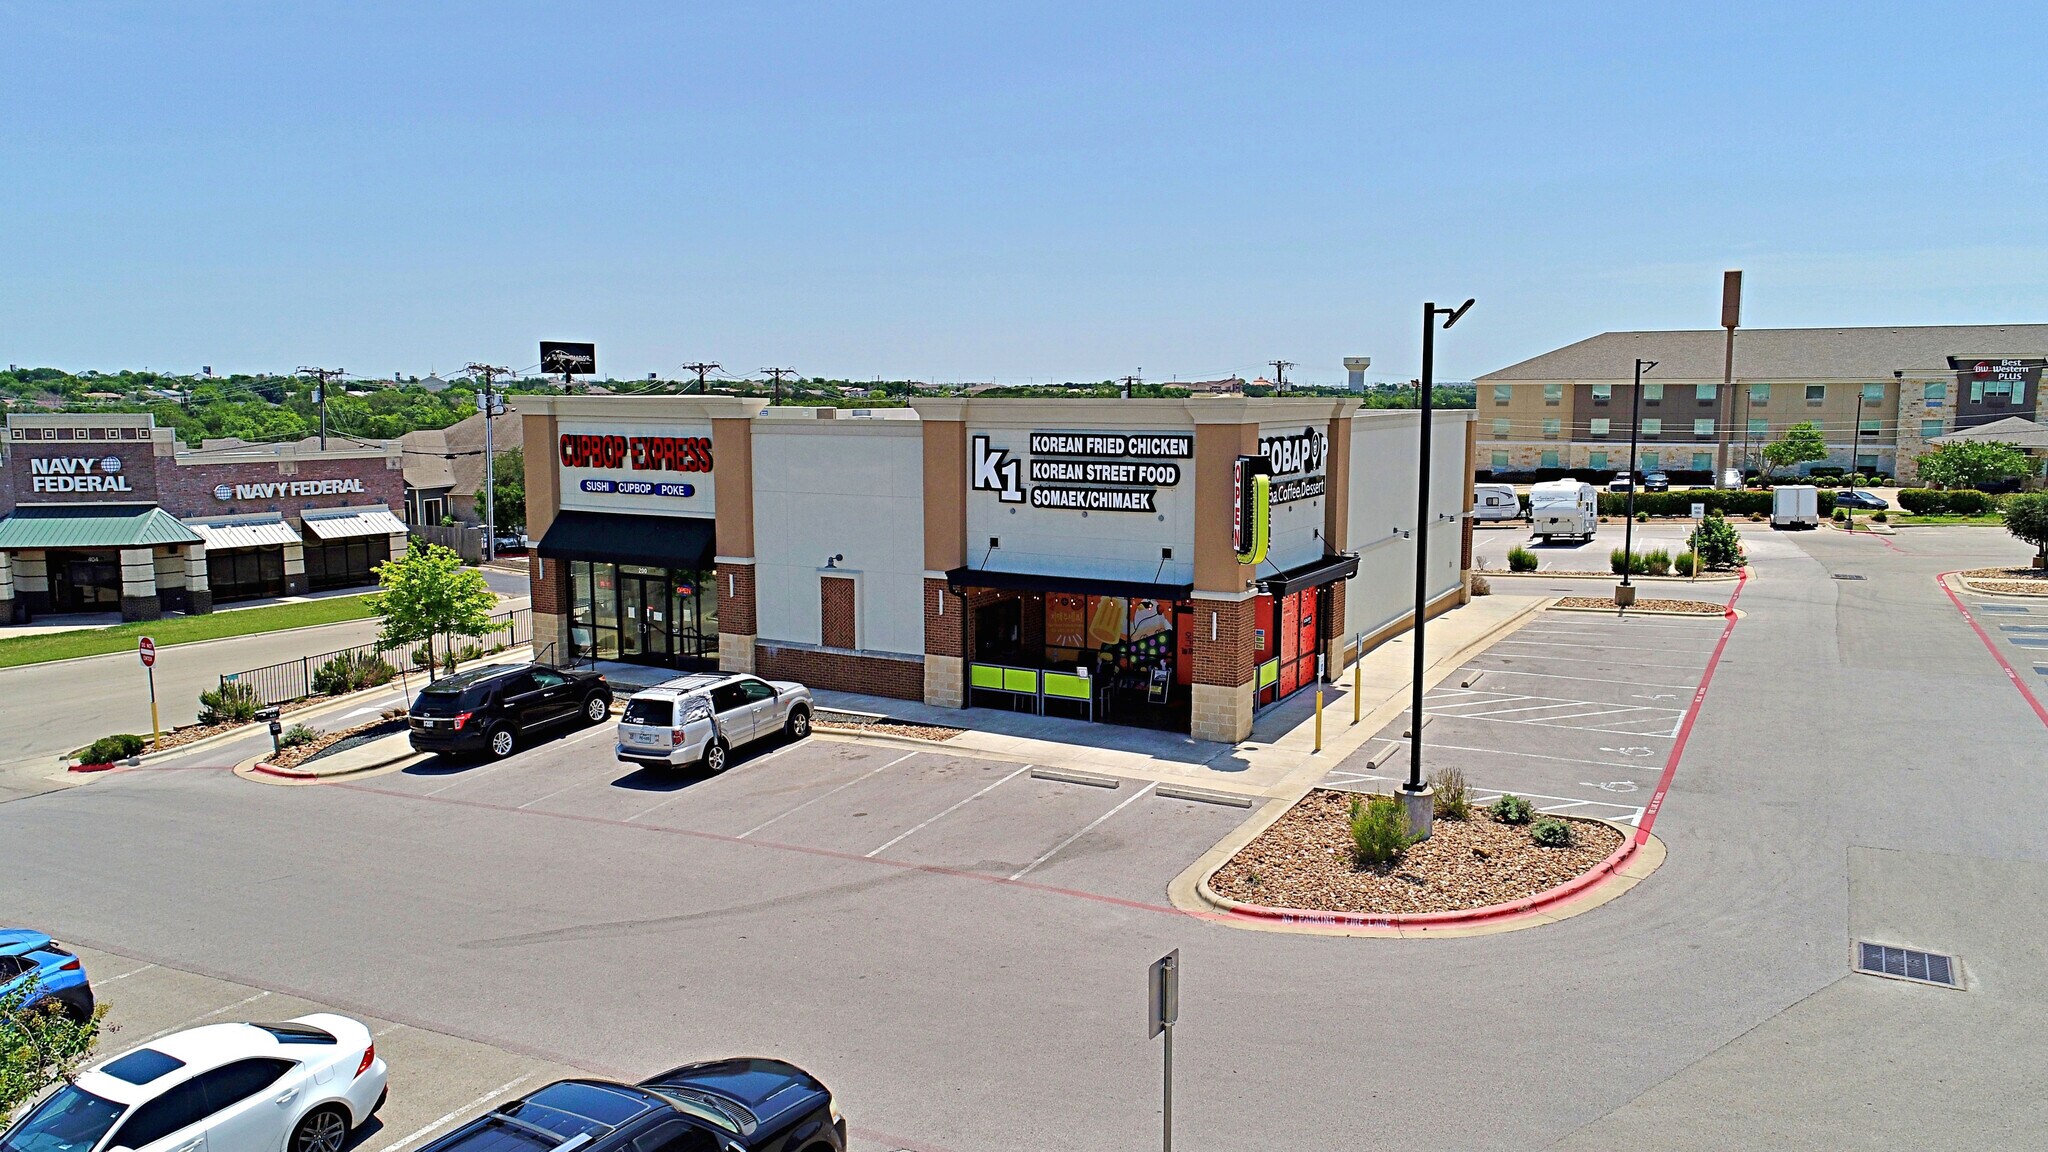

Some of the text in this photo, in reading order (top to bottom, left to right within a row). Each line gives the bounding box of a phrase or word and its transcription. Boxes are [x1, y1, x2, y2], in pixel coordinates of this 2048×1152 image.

[1993, 365, 2029, 373] Western
[559, 433, 713, 473] CUPBOP EXPRESS
[1032, 436, 1188, 456] KOREAN FRIED CHICKEN
[30, 458, 95, 475] NAVY
[1032, 462, 1176, 484] KOREAN STREET FOOD
[32, 476, 132, 492] FEDERAL
[236, 478, 364, 499] NAVY FEDERAL
[586, 480, 685, 496] SUSHI CUPBOP POKE
[1033, 488, 1150, 509] SOMAEK/CHIMAEK
[676, 586, 692, 595] OPEN
[1282, 913, 1391, 928] NO PARKING FIRE LANE
